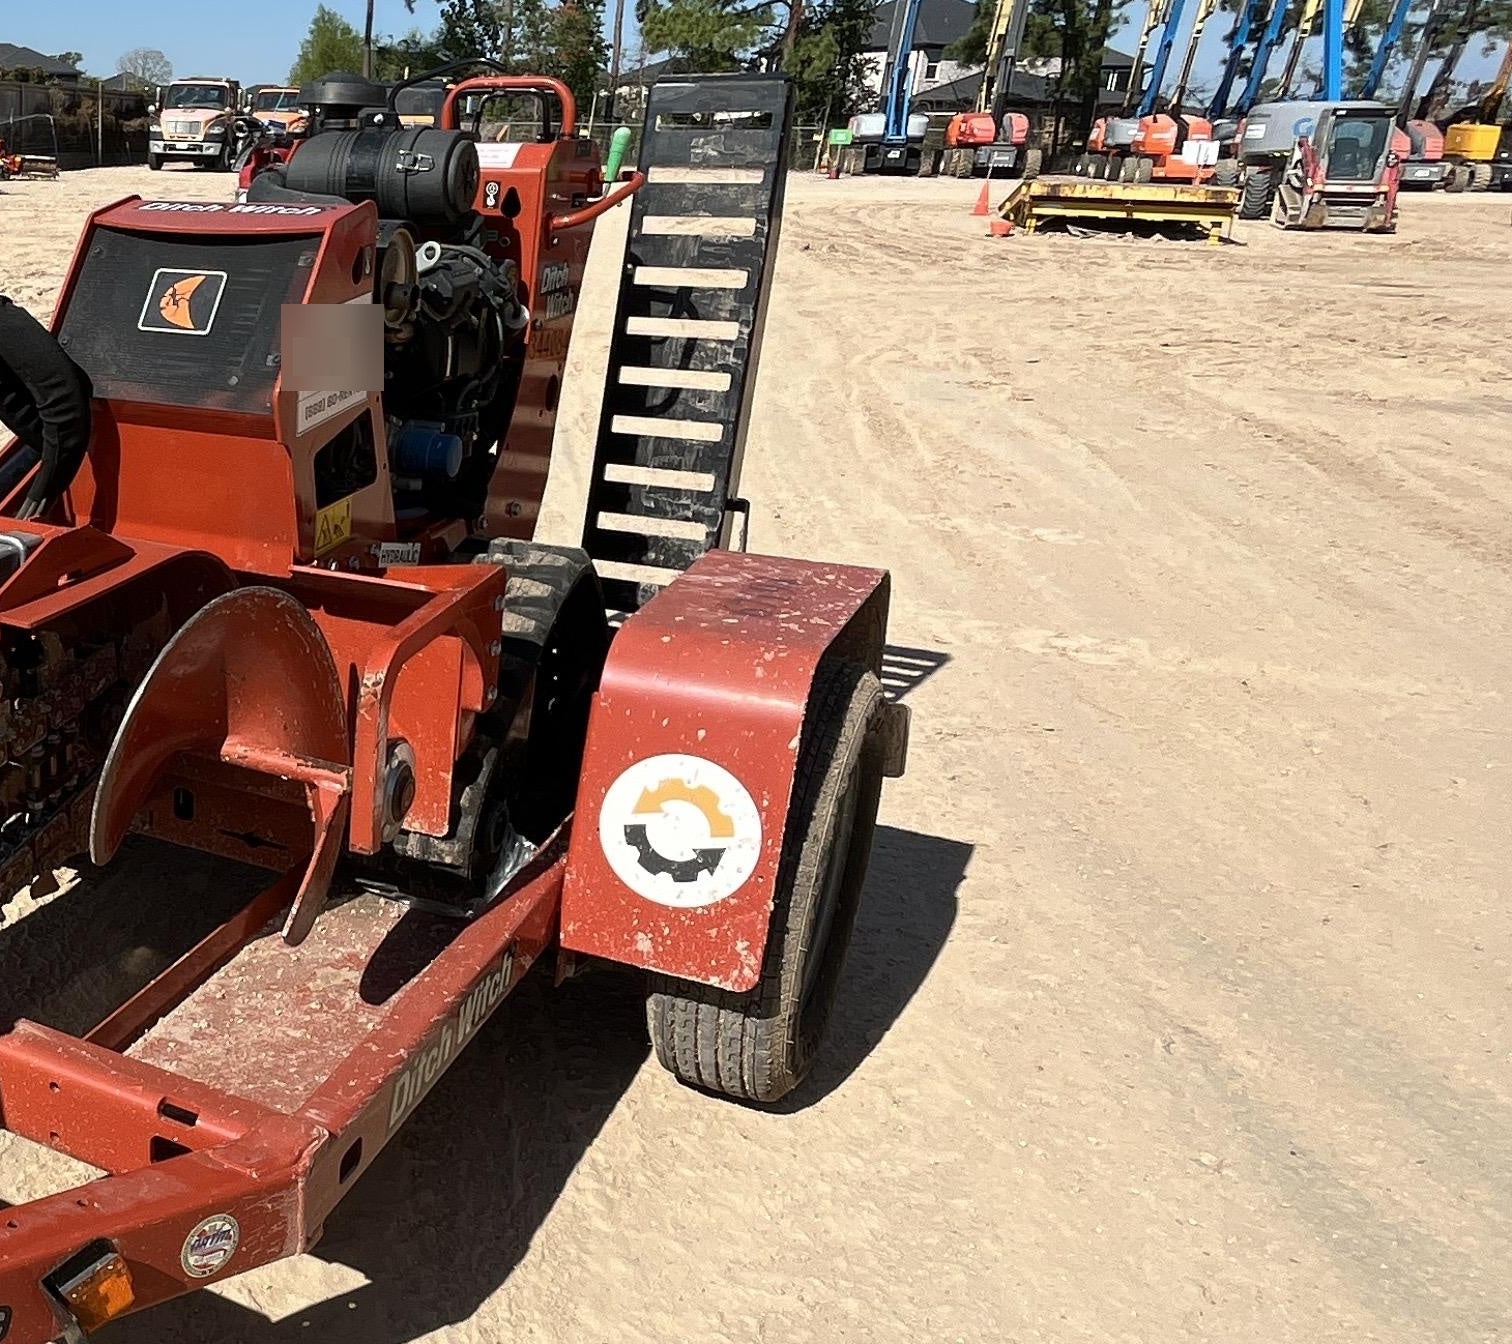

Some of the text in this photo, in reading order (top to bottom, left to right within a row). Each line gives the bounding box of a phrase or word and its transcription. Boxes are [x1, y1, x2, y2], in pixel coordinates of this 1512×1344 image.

[138, 202, 322, 215] Ditch Witch
[541, 262, 569, 294] Ditch
[546, 288, 575, 320] Witch
[389, 951, 513, 1128] Ditch Witch
